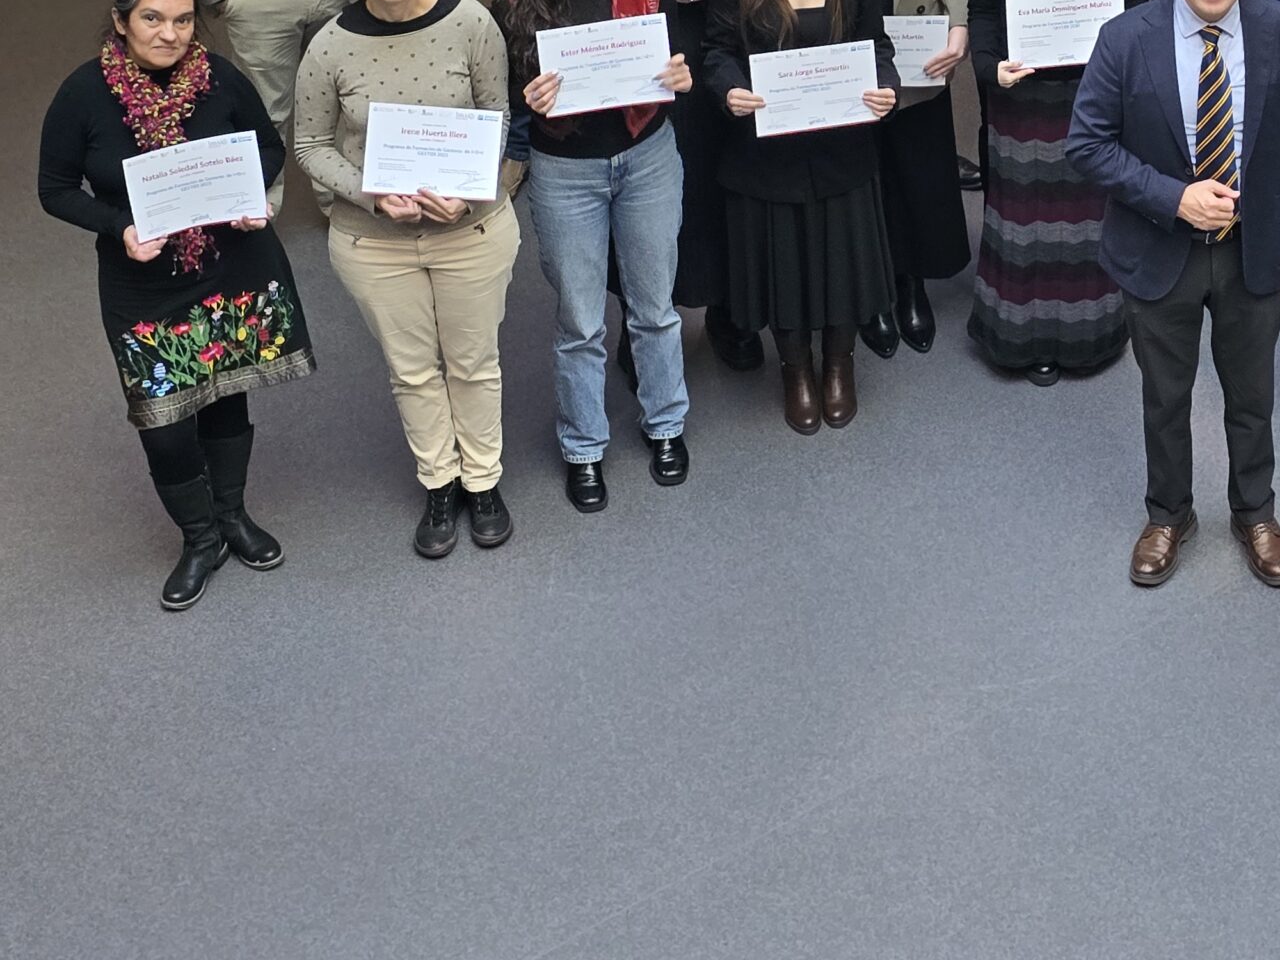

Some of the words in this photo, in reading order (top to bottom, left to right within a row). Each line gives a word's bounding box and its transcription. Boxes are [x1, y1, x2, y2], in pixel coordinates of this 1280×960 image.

[401, 127, 420, 136] Irene
[421, 128, 448, 137] Huerta
[142, 170, 168, 183] Natalia
[169, 162, 199, 176] Soledad
